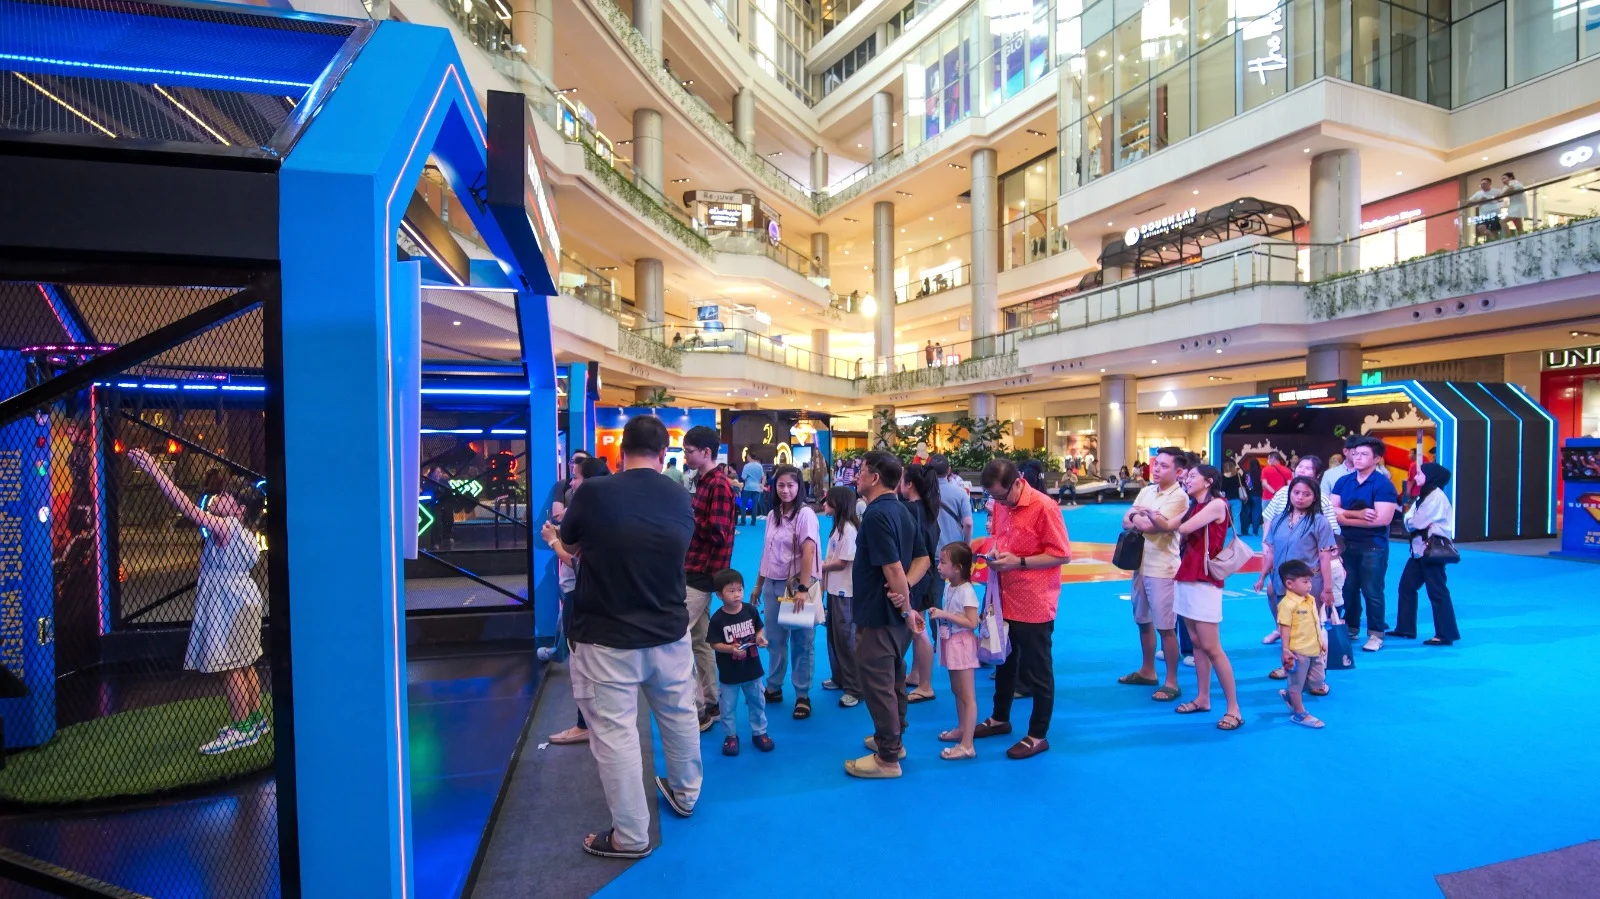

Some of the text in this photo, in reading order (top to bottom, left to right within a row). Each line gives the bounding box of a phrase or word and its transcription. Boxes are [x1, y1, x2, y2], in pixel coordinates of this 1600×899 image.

[1141, 207, 1197, 234] DOUGH LAB
[723, 619, 754, 643] CHANGE
